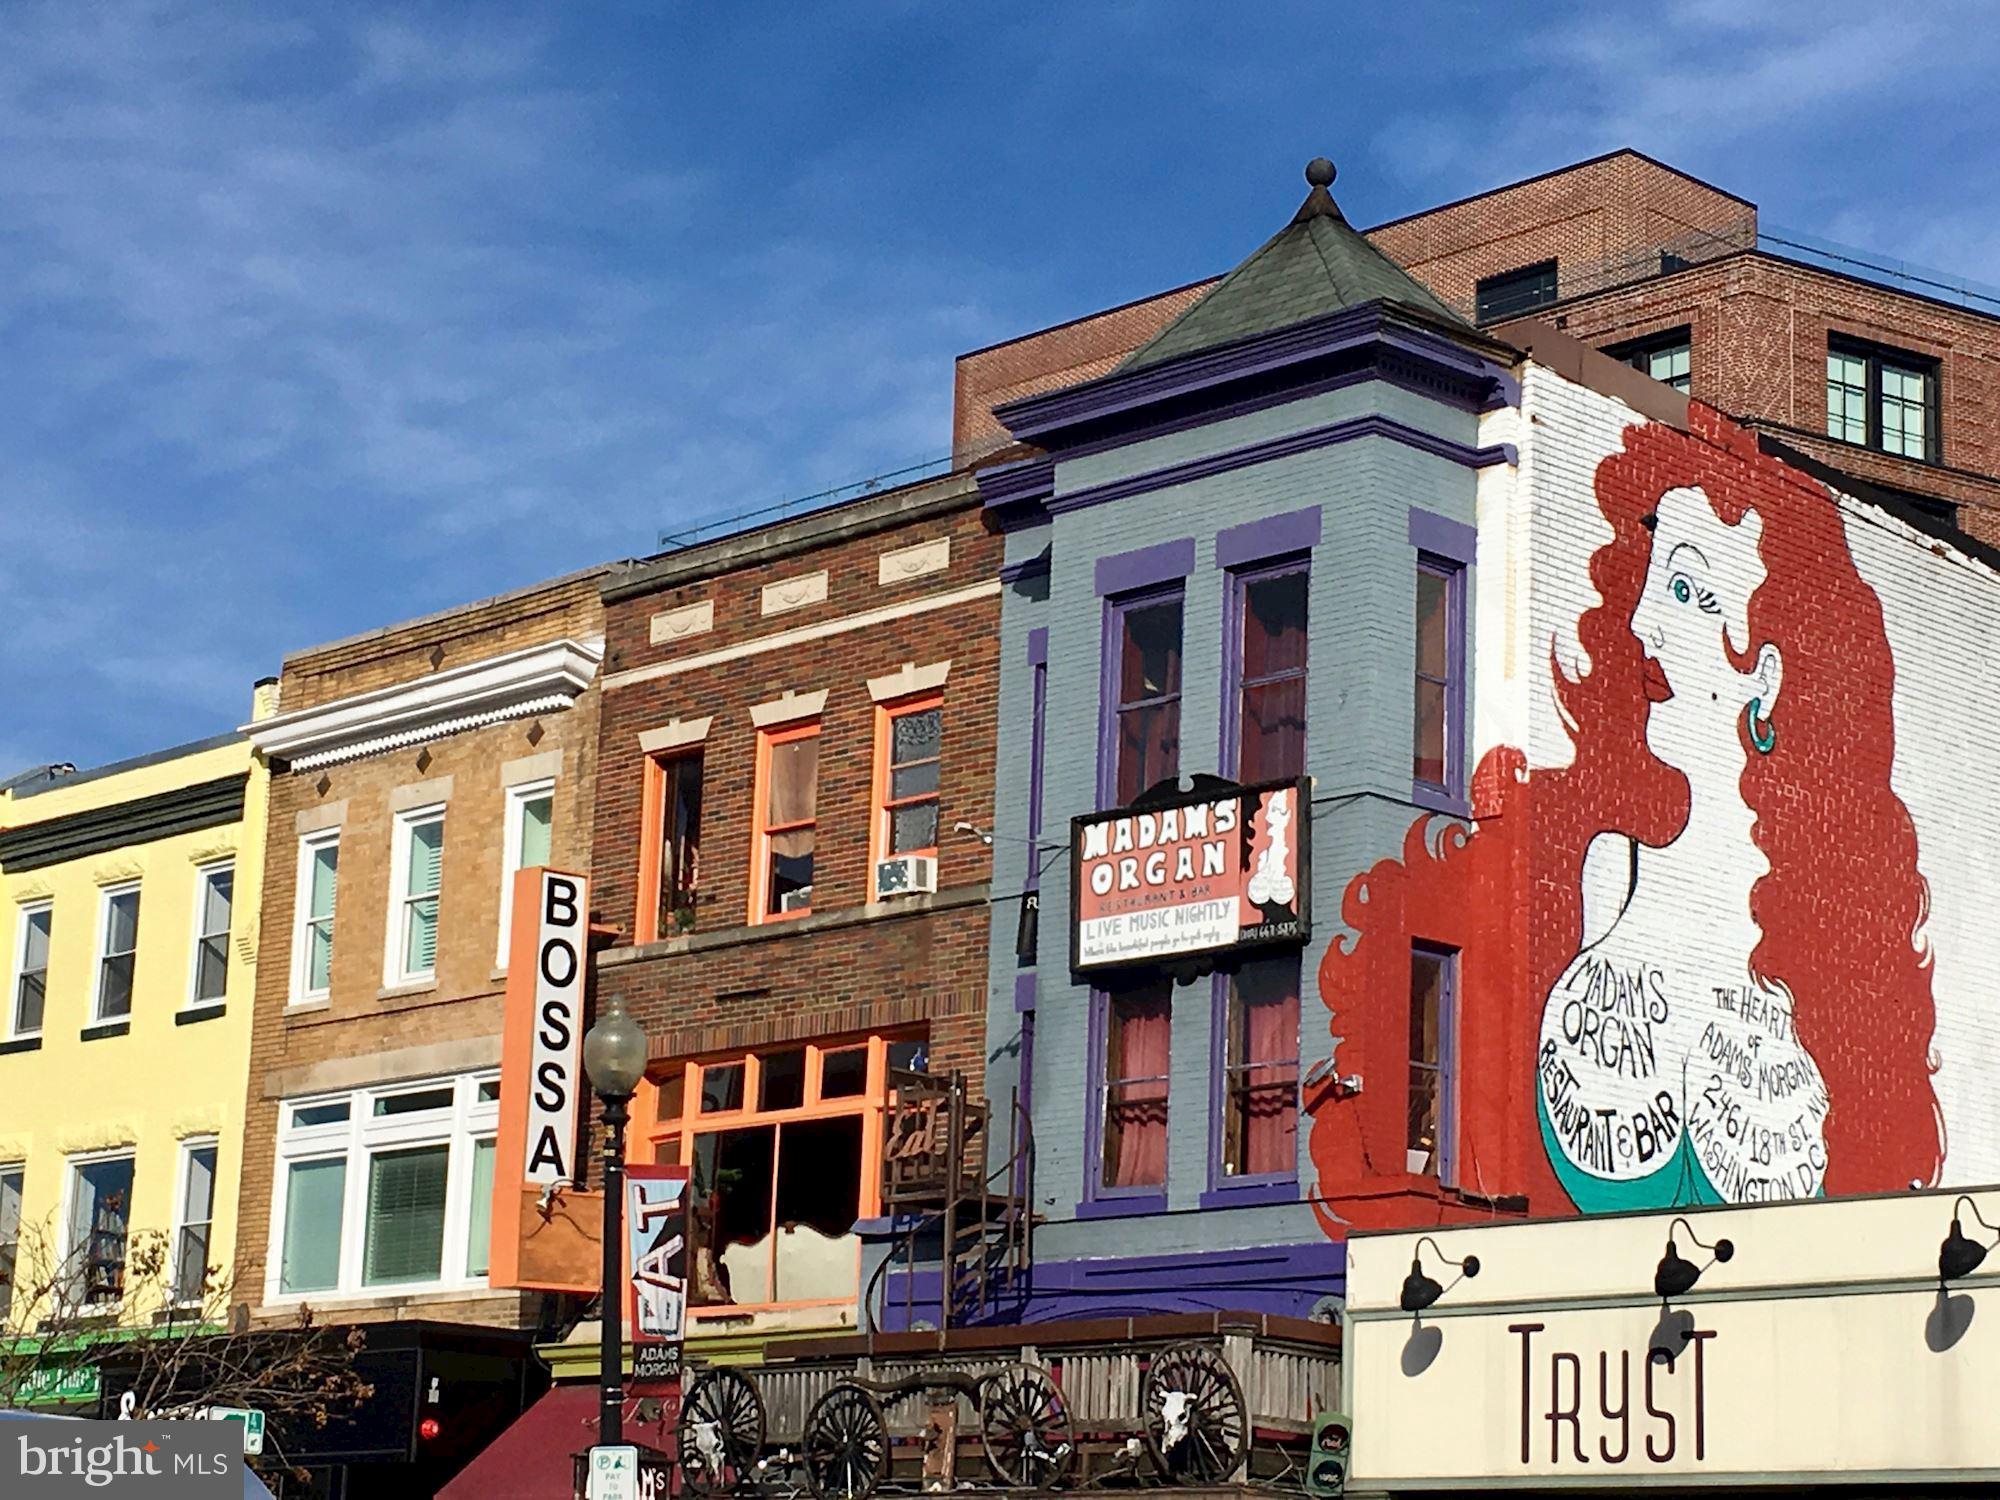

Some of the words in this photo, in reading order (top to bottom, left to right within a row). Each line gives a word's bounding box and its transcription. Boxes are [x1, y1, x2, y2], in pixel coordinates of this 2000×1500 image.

[1082, 797, 1237, 861] MADAM'S
[1090, 840, 1226, 896] ORGAN
[1191, 885, 1211, 898] BAR
[1086, 918, 1122, 940] LIVE
[1129, 910, 1170, 932] MUSIC
[1175, 901, 1231, 929] NIGHTLY
[1565, 955, 1669, 1024] MADAM'S
[1712, 987, 1737, 1012] THE
[1740, 985, 1792, 1041] HEART
[528, 876, 578, 1177] BOSSA
[1563, 1000, 1656, 1079] ORGAN
[1748, 1034, 1762, 1058] OF
[1699, 1021, 1753, 1089] ADAMS
[1758, 1054, 1816, 1104] MORGAN
[1541, 1038, 1617, 1173] RESTAURANT
[1632, 1090, 1680, 1163] BAR
[1703, 1074, 1750, 1145] 2461
[1688, 1102, 1796, 1203] WASHINGTON
[634, 1361, 680, 1377] MORGAN
[639, 1346, 679, 1361] ADAMS
